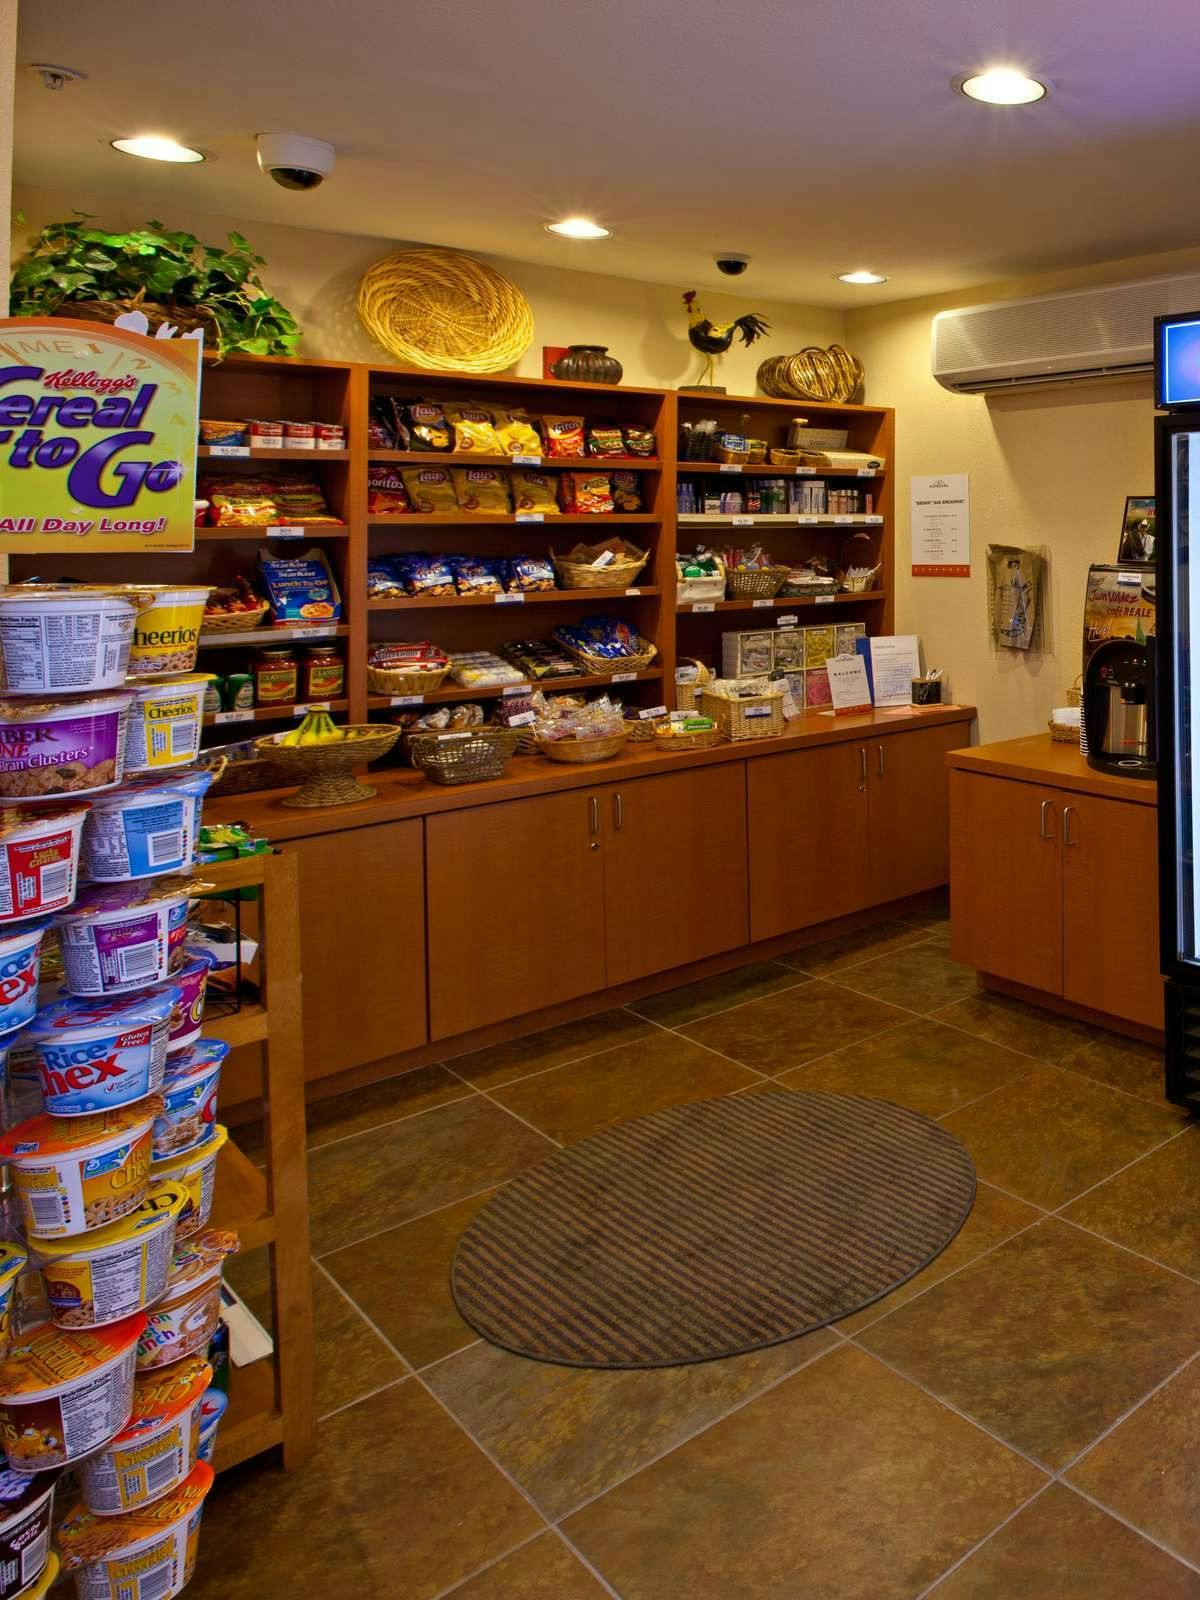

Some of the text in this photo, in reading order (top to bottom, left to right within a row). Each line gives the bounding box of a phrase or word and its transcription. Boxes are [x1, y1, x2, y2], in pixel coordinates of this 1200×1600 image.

[44, 369, 138, 393] Kellogg's
[9, 429, 182, 509] to Go
[0, 519, 166, 534] All Day Long!
[134, 626, 198, 646] heerios
[833, 669, 862, 677] WELCOME
[149, 703, 194, 719] Cheerios
[0, 727, 59, 745] BER
[0, 744, 30, 759] NE
[28, 748, 88, 768] Clusters
[120, 1030, 150, 1043] Gluten
[122, 1038, 145, 1047] Free!
[43, 1044, 107, 1071] Rice
